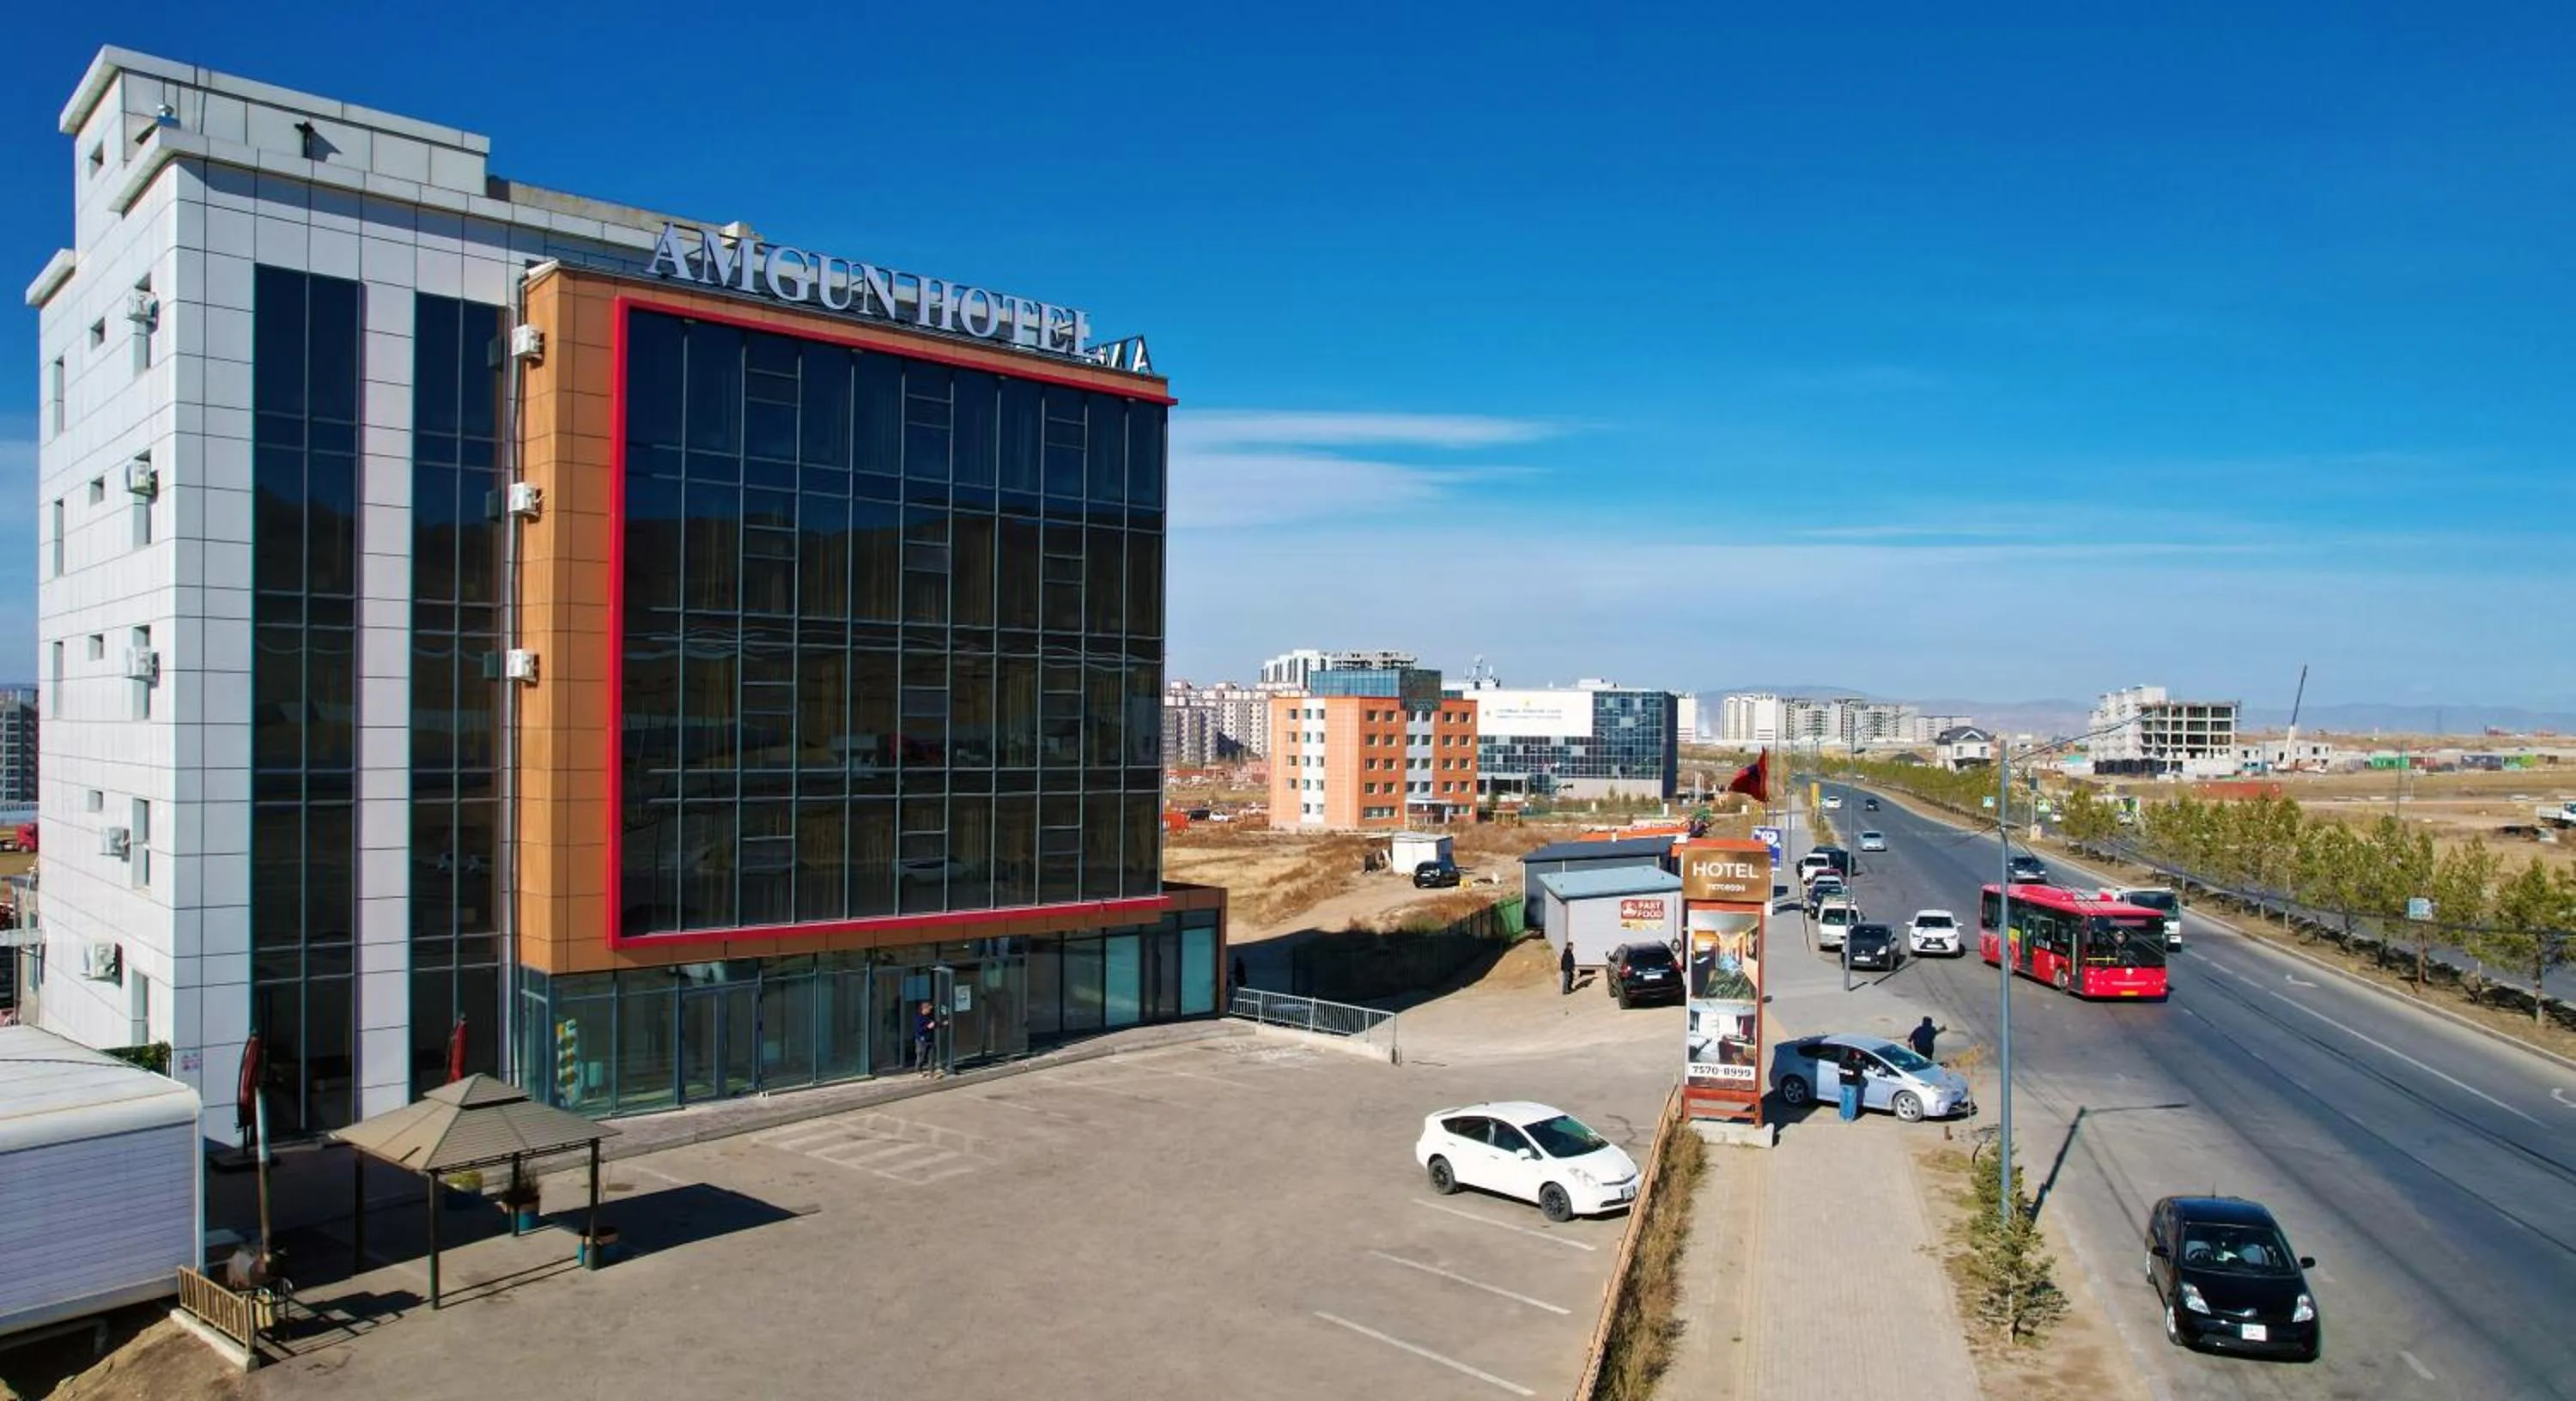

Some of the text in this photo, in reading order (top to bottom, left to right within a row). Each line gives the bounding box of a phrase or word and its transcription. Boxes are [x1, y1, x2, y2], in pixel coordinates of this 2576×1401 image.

[646, 221, 1102, 361] AMGUN HOTEL
[1692, 861, 1759, 878] HOTEL
[1637, 901, 1662, 909] FAST
[1637, 909, 1663, 918] FOOD
[1692, 1064, 1752, 1077] 7570-8999
